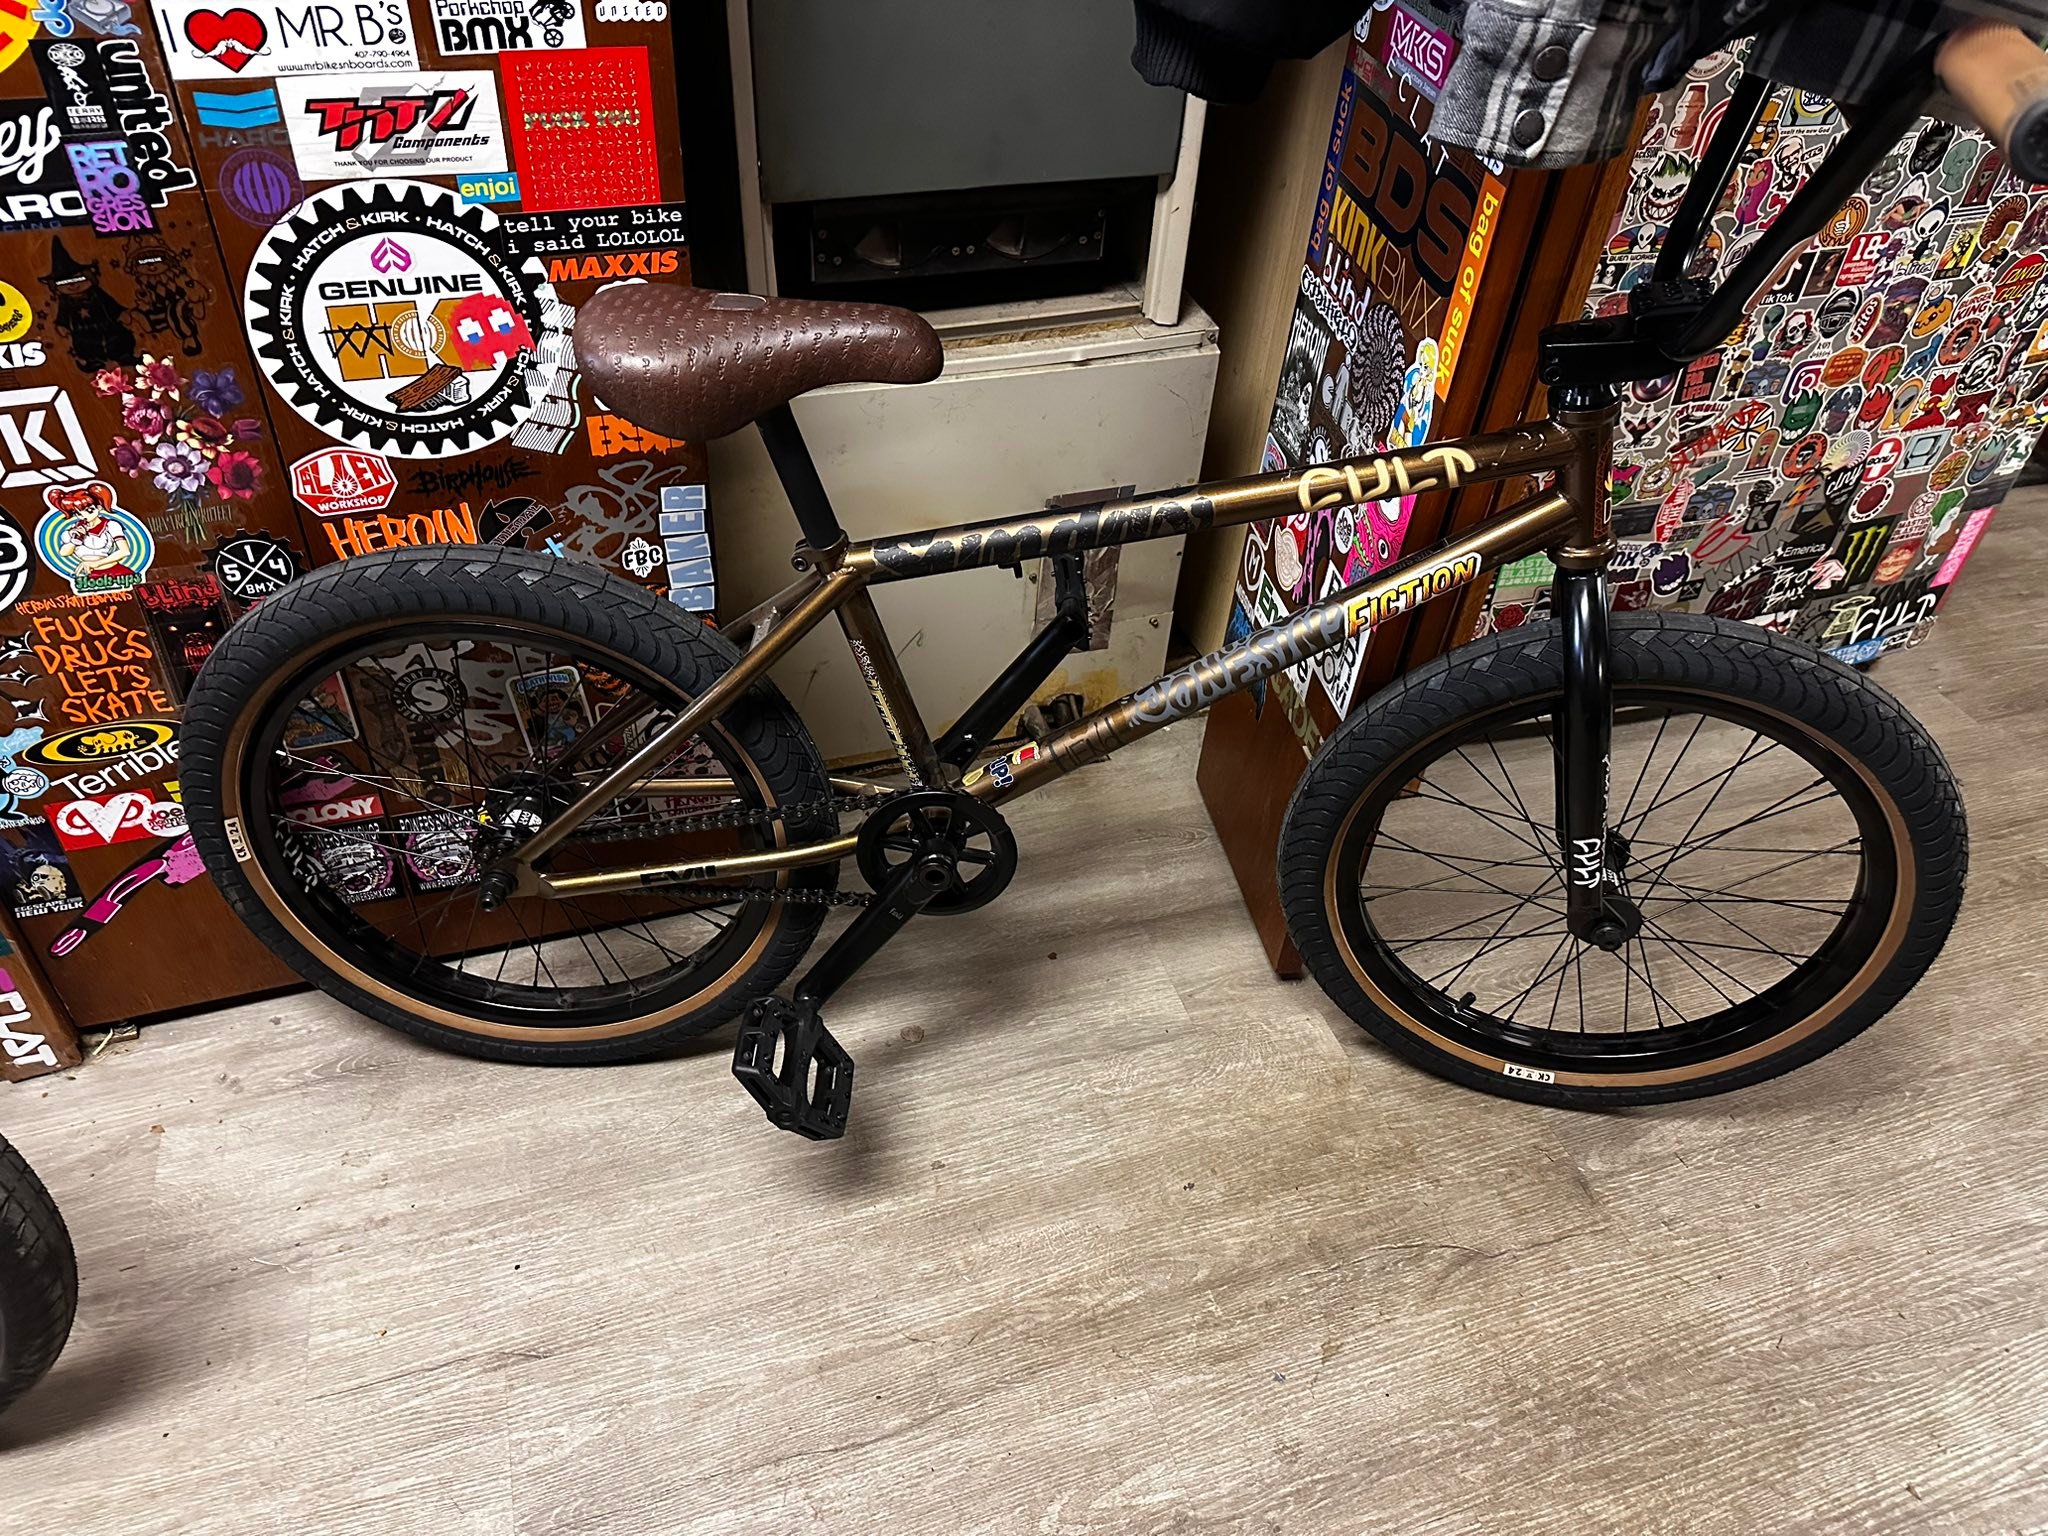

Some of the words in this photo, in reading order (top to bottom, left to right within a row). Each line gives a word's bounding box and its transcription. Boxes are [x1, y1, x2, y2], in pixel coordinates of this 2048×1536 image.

[436, 0, 525, 17] Porkchop
[599, 5, 664, 17] UNITED
[275, 5, 352, 48] MR.
[439, 16, 534, 51] BMX
[1390, 9, 1447, 82] MKS
[277, 60, 413, 72] www.mrbikesnboards.com
[524, 112, 590, 130] FUCK
[593, 109, 640, 127] YOU
[392, 133, 491, 150] Components
[1310, 201, 1331, 252] bag
[1325, 163, 1336, 192] of
[1332, 83, 1353, 156] suck
[460, 177, 516, 198] enjoi
[1340, 97, 1473, 285] BDS
[504, 216, 556, 233] tell
[568, 214, 622, 232] your
[631, 209, 682, 224] bike
[1467, 191, 1500, 259] bag
[293, 222, 345, 271] HATCH
[361, 211, 410, 225] KIRK
[508, 240, 520, 254] i
[533, 234, 585, 252] said
[597, 227, 685, 248] LOLOLOL
[426, 215, 491, 256] HATCH
[499, 265, 527, 306] KIRK
[549, 250, 680, 283] MAXXIS
[1328, 184, 1388, 284] KINK
[1376, 240, 1443, 339] BMX
[1997, 262, 2046, 286] SANTA
[318, 273, 483, 301] GENUINE
[1322, 241, 1373, 328] blind
[1455, 265, 1475, 307] of
[279, 282, 296, 327] KIRK
[1954, 301, 1991, 320] KING
[1436, 309, 1464, 386] suck
[290, 342, 331, 399] HATCH
[338, 401, 383, 429] KIRK
[480, 384, 512, 417] KIRK
[401, 416, 465, 435] HATCH
[297, 449, 391, 494] ALIEN
[1298, 447, 1476, 512] CULT
[316, 495, 386, 513] WORKSHOP
[320, 501, 478, 561] HEROIN
[661, 483, 716, 613] BAKER
[623, 548, 662, 570] FBC
[1783, 544, 1825, 557] Emerica
[74, 572, 143, 591] Hook-ups
[223, 563, 242, 582] 5
[269, 557, 288, 576] 4
[134, 574, 222, 609] blind
[246, 582, 277, 595] BMX
[1347, 556, 1477, 638] FICTION
[33, 606, 127, 643] FUCK
[1850, 593, 1936, 644] CULT
[34, 630, 153, 674] DRUGS
[58, 665, 151, 698] LET'S
[61, 689, 174, 724] SKATE
[14, 900, 64, 912] EGGSCAPE
[16, 908, 48, 919] NEW
[51, 901, 84, 911] YOLK
